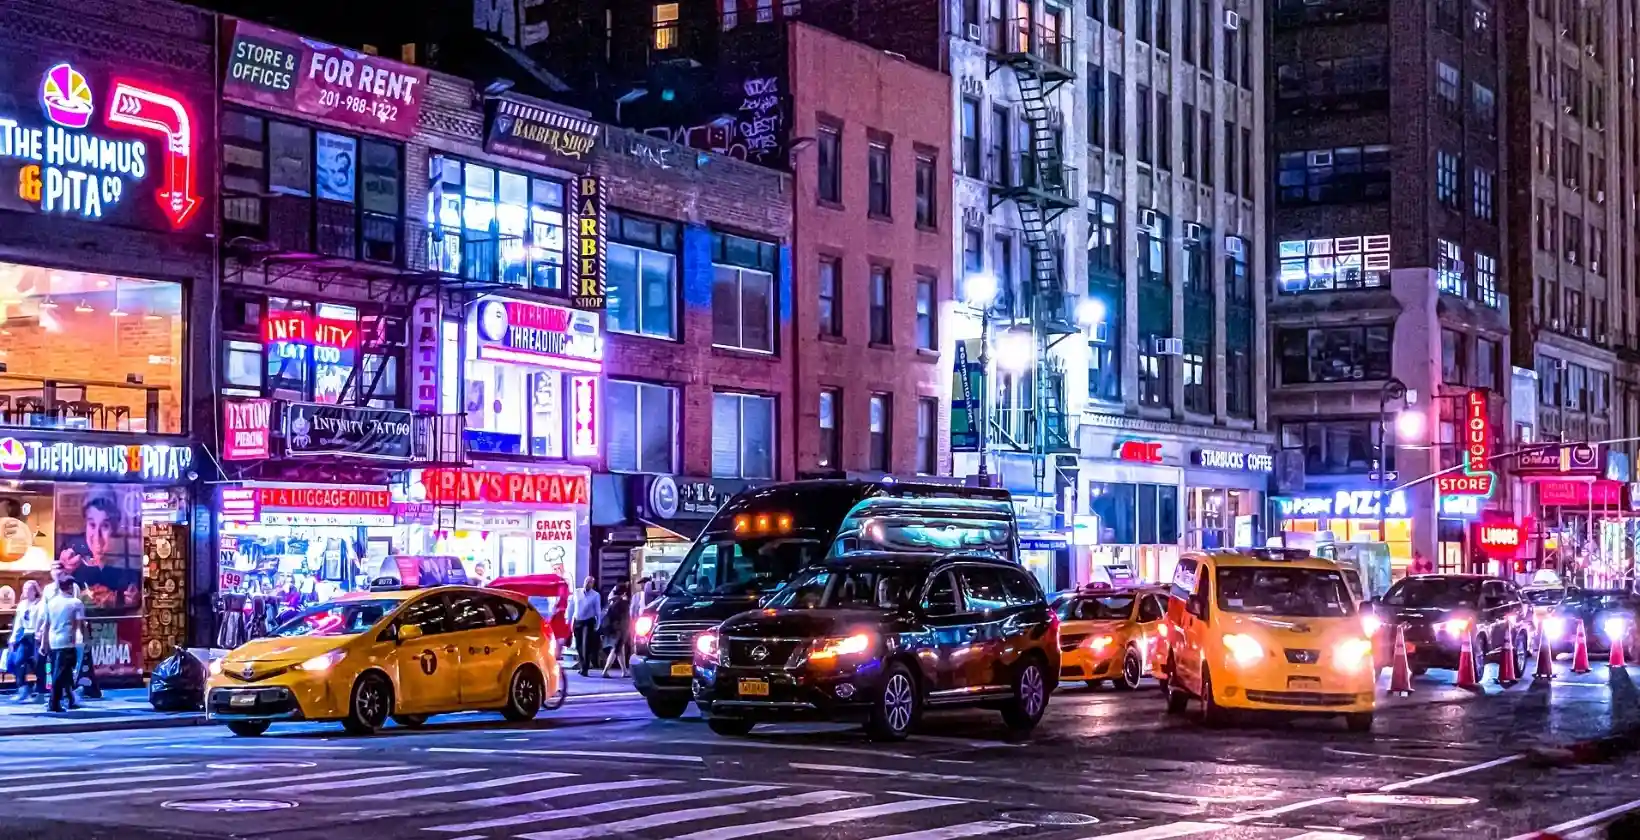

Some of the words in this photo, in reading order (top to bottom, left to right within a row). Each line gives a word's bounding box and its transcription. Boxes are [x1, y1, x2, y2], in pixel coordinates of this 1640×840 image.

[237, 42, 283, 68] STORE
[285, 54, 294, 70] &
[232, 62, 291, 90] OFFICES
[309, 53, 355, 88] FOR
[358, 65, 418, 105] RENT
[0, 119, 43, 160] THE
[47, 126, 145, 178] HUMMUS
[512, 117, 564, 148] BARBER
[562, 131, 594, 154] SHOP
[19, 165, 42, 201] &
[47, 167, 101, 216] PITA
[579, 178, 598, 297] BARBER
[576, 298, 602, 307] SHOP
[268, 319, 353, 348] INFINITY
[510, 325, 566, 354] THREADING
[228, 401, 271, 429] TATTOO
[313, 414, 366, 436] INFINITY
[370, 419, 410, 435] TATTOO
[1471, 393, 1485, 469] LIQUOR
[60, 442, 128, 476] HUMMUS
[142, 444, 179, 480] PITA
[1201, 449, 1244, 469] STARBUCKS
[1247, 453, 1273, 472] COFFEE
[508, 474, 588, 504] PAPAYA
[1440, 478, 1487, 490] STORE
[291, 489, 347, 507] LUGGAGE
[348, 491, 390, 508] OUTLET
[535, 531, 573, 541] PAPAYA
[536, 520, 571, 531] GRAY'S
[220, 551, 234, 561] NY
